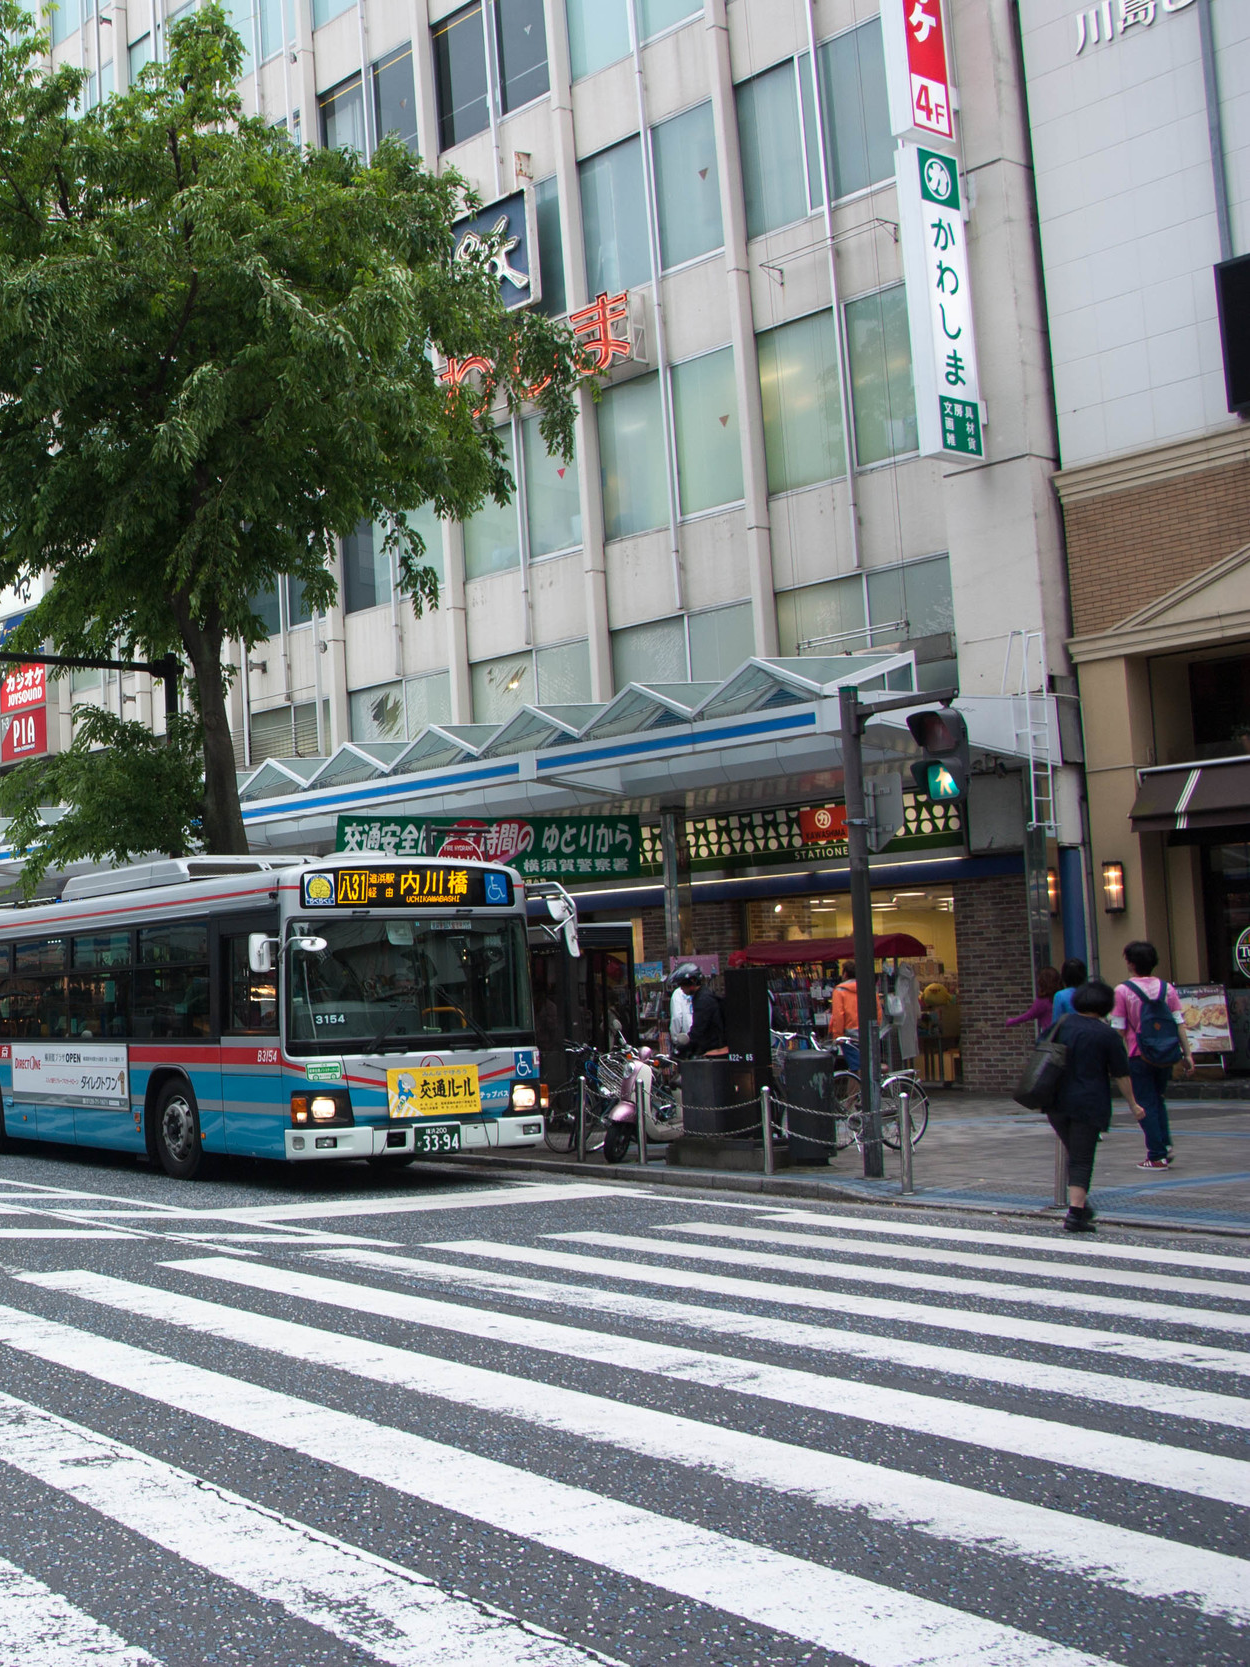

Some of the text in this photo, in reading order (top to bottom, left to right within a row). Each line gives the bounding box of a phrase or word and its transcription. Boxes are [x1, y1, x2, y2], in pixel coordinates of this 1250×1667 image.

[908, 0, 938, 43] ケ
[915, 83, 946, 126] 4F
[930, 217, 966, 388] かわしま
[5, 666, 45, 693] カラオケ
[7, 686, 43, 708] JOYSOUND
[13, 715, 36, 747] PIA
[542, 822, 633, 853] ゆとりから
[806, 828, 846, 840] KAWASHIMA
[523, 857, 629, 873] 横須賀警察署
[339, 872, 367, 902] 八31
[368, 872, 395, 884] 追浜駅
[400, 869, 469, 895] 内川橋
[405, 894, 461, 903] UCHIKAWABASHI
[315, 1014, 346, 1024] 3154
[65, 1053, 82, 1063] OPEN
[257, 1049, 278, 1063] B3154
[80, 1070, 118, 1092] ダイレクトワン
[420, 1076, 476, 1100] 交通ルール
[422, 1132, 460, 1152] 33-94
